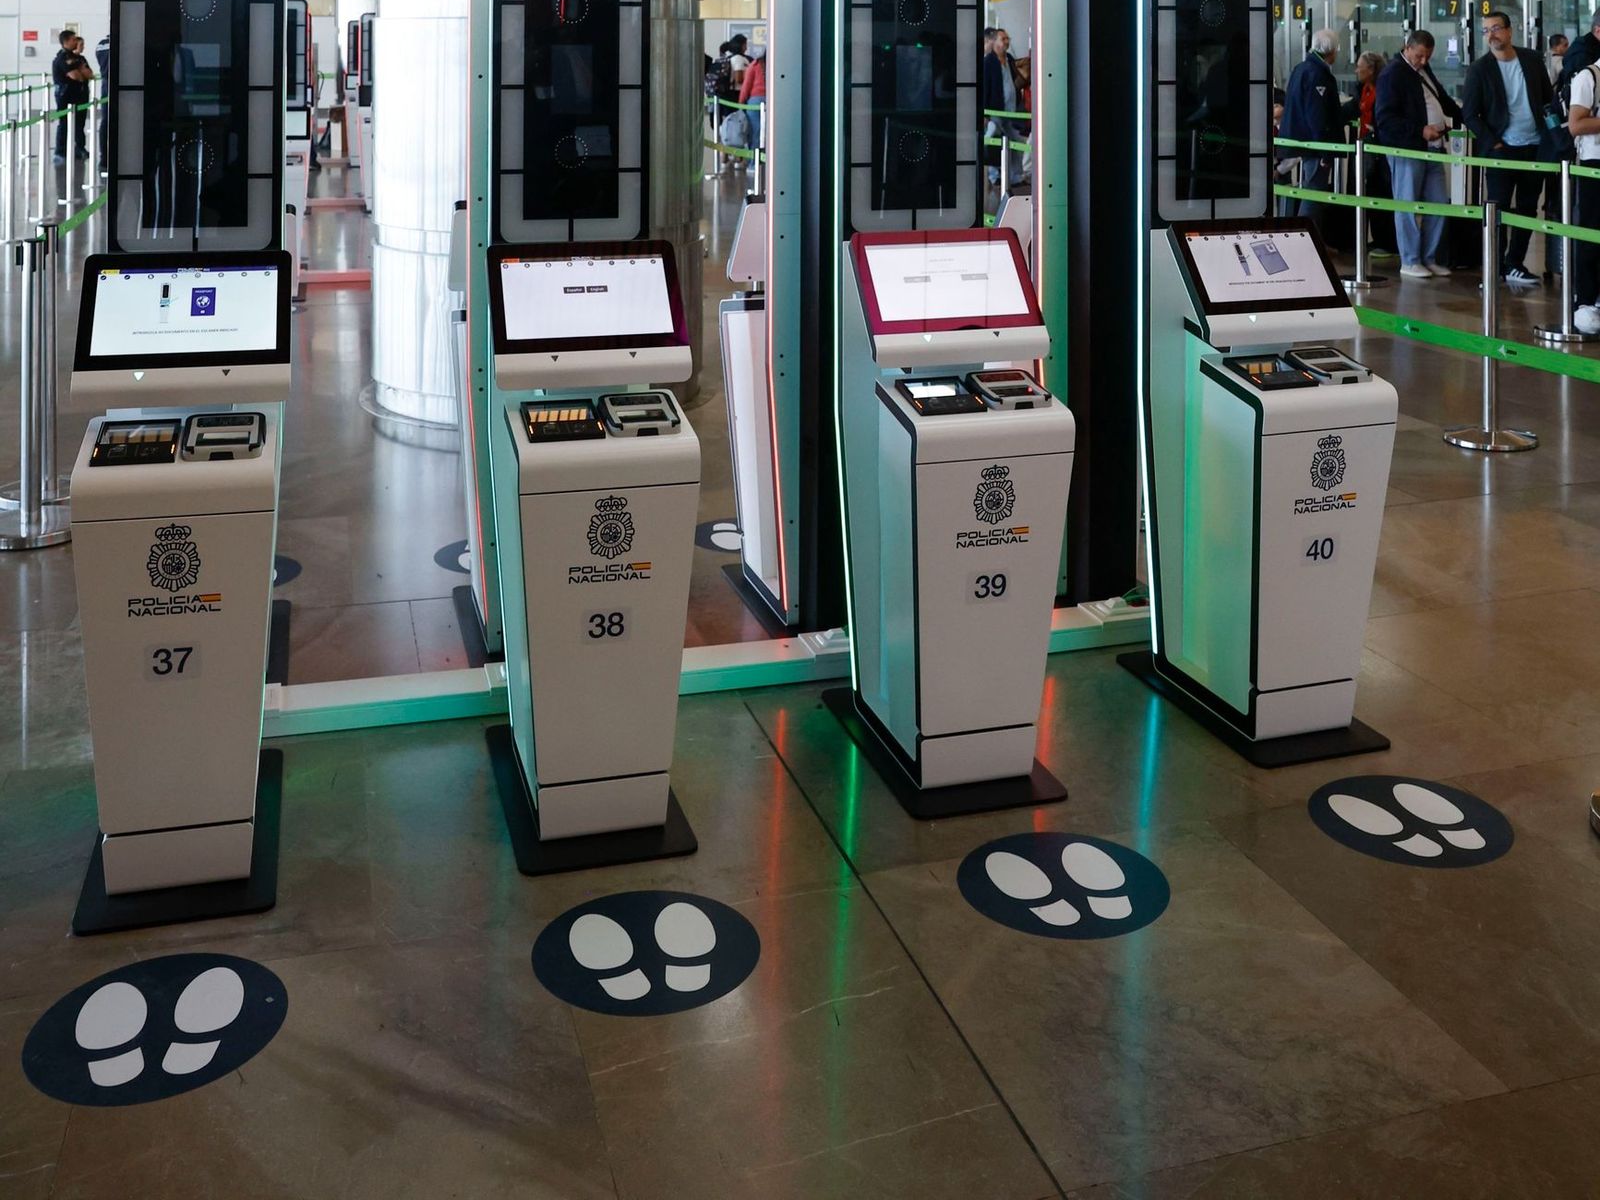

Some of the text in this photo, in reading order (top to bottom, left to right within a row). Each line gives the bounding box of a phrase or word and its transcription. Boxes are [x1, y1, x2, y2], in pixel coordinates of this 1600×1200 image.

[1274, 4, 1281, 18] 5
[1296, 4, 1302, 18] 6
[1450, 0, 1457, 15] 7
[1482, 0, 1490, 15] 8
[1294, 494, 1344, 507] POLICIA
[1293, 501, 1356, 515] NACIONAL
[956, 528, 1014, 541] POLICIA
[956, 535, 1029, 549] NACIONAL
[1305, 537, 1335, 561] 40
[568, 563, 634, 575] POLICIA
[568, 571, 652, 585] NACIONAL
[974, 573, 1007, 599] 39
[127, 595, 201, 608] POLICIA
[127, 603, 222, 618] NACIONAL
[588, 612, 625, 639] 38
[152, 646, 193, 675] 37
